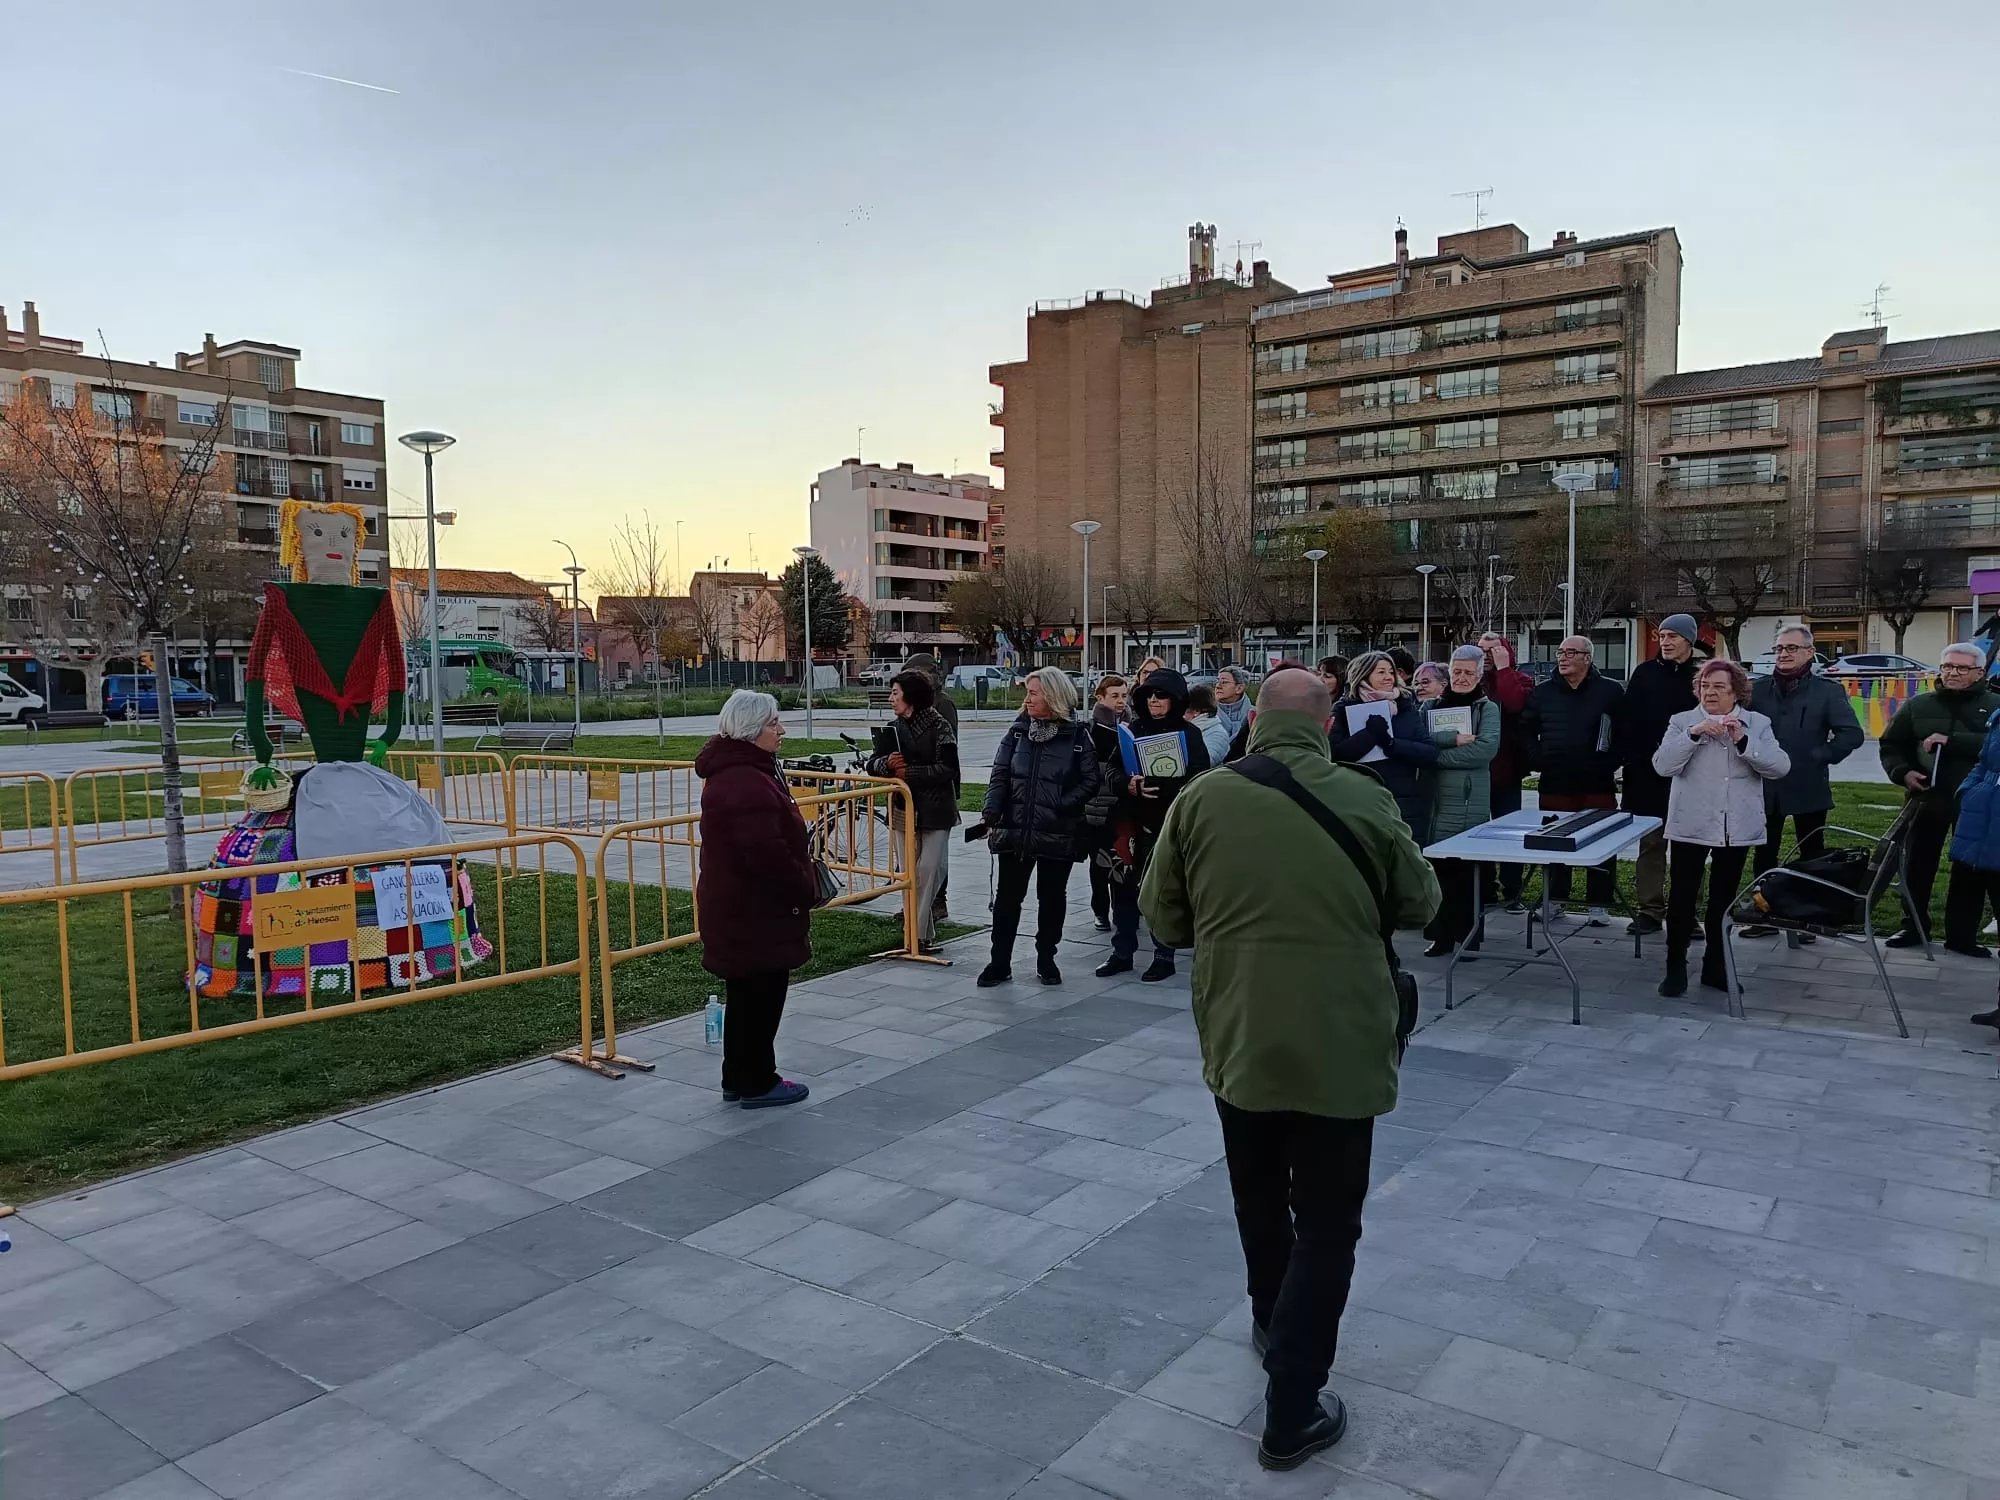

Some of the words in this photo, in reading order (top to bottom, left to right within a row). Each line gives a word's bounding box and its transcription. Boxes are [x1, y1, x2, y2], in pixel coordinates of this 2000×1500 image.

[1145, 741, 1175, 754] CORO
[381, 871, 440, 890] GANCILLERAS
[414, 890, 425, 899] LA
[307, 915, 340, 925] Huesca
